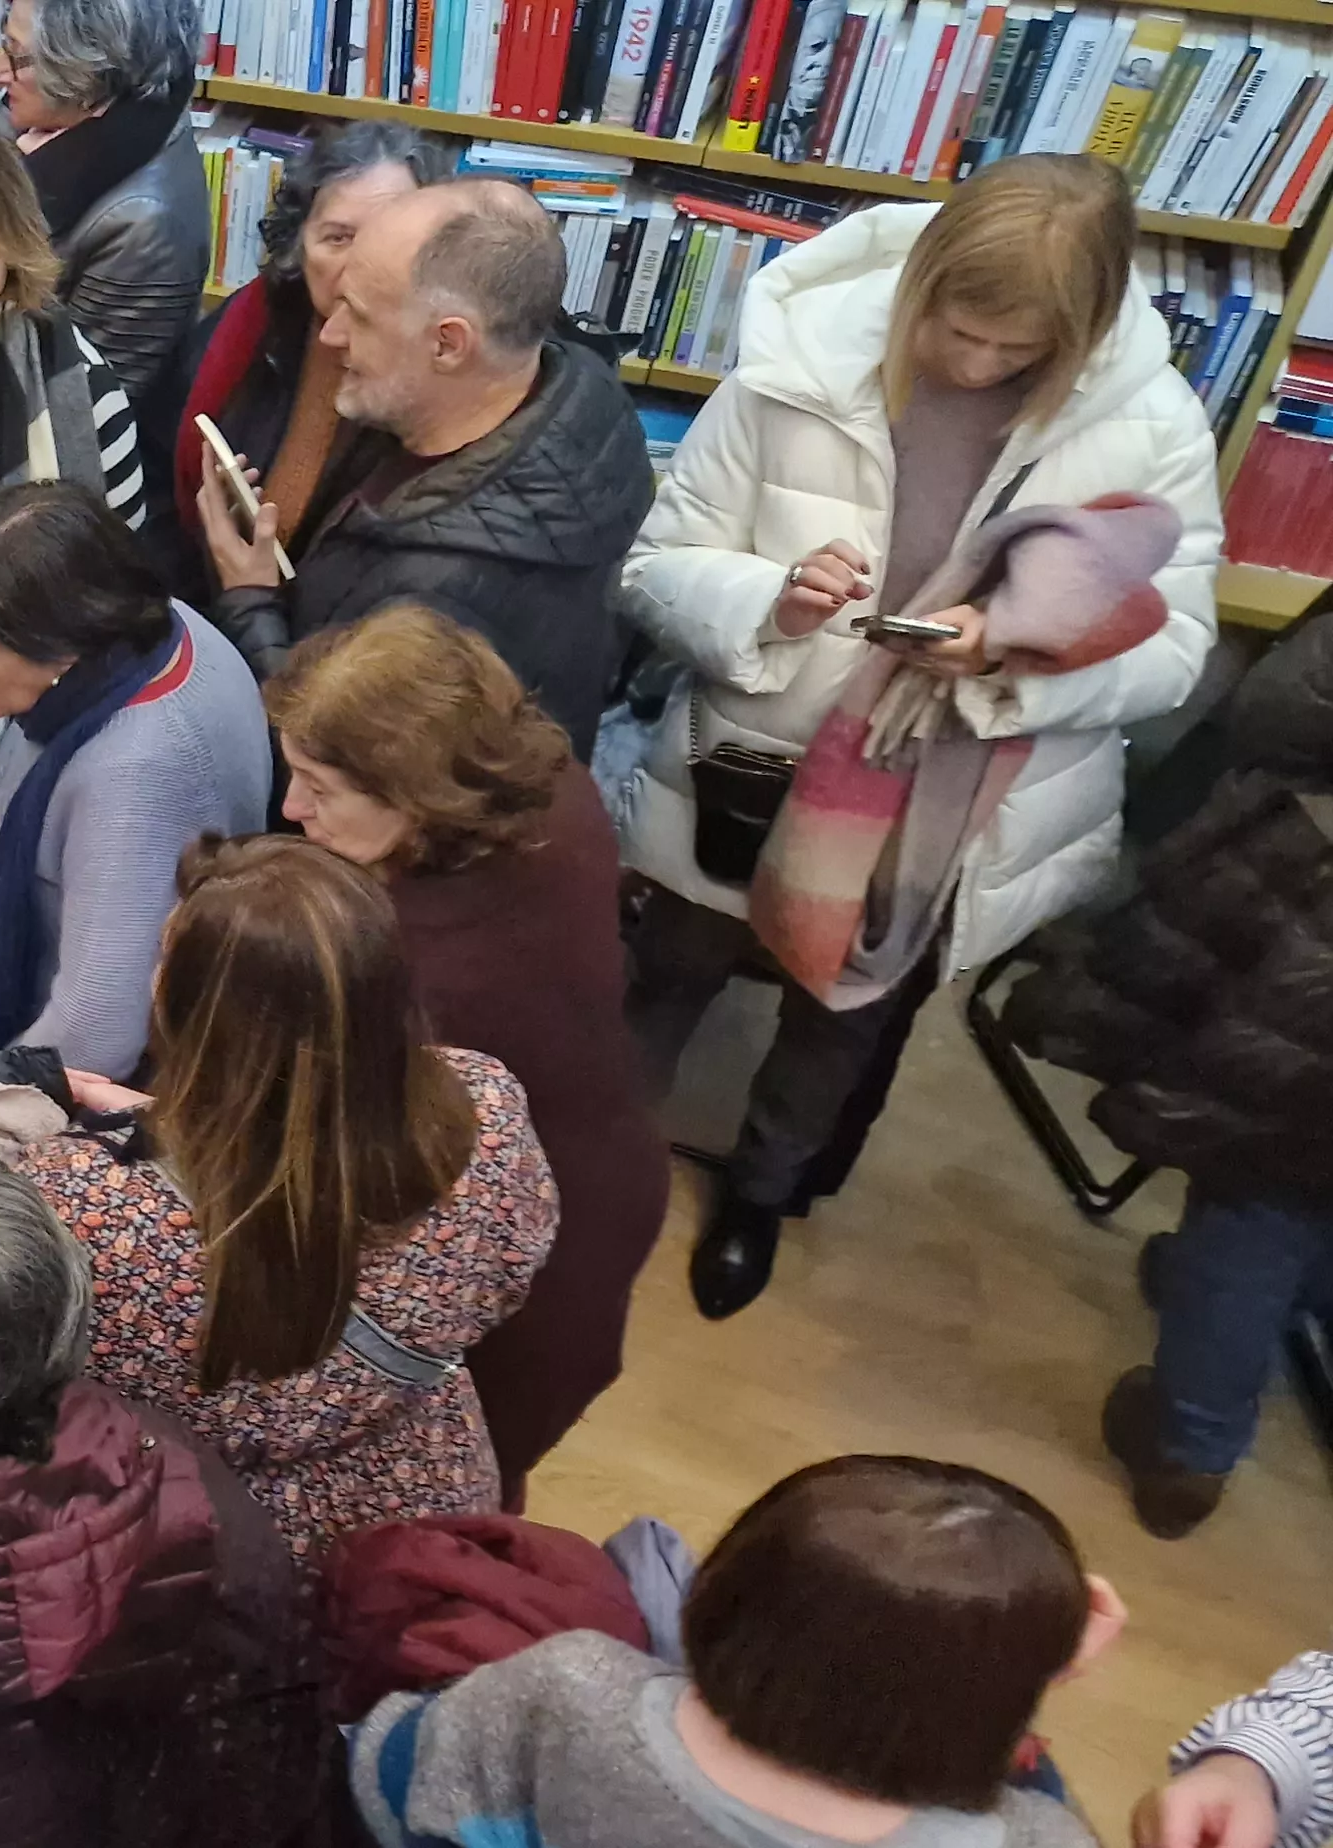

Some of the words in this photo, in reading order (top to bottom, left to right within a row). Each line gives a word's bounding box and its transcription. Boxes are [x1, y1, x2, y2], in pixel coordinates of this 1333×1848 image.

[621, 6, 653, 63] 1942
[1229, 68, 1268, 124] MONSTRUOS
[643, 250, 661, 284] PODER
